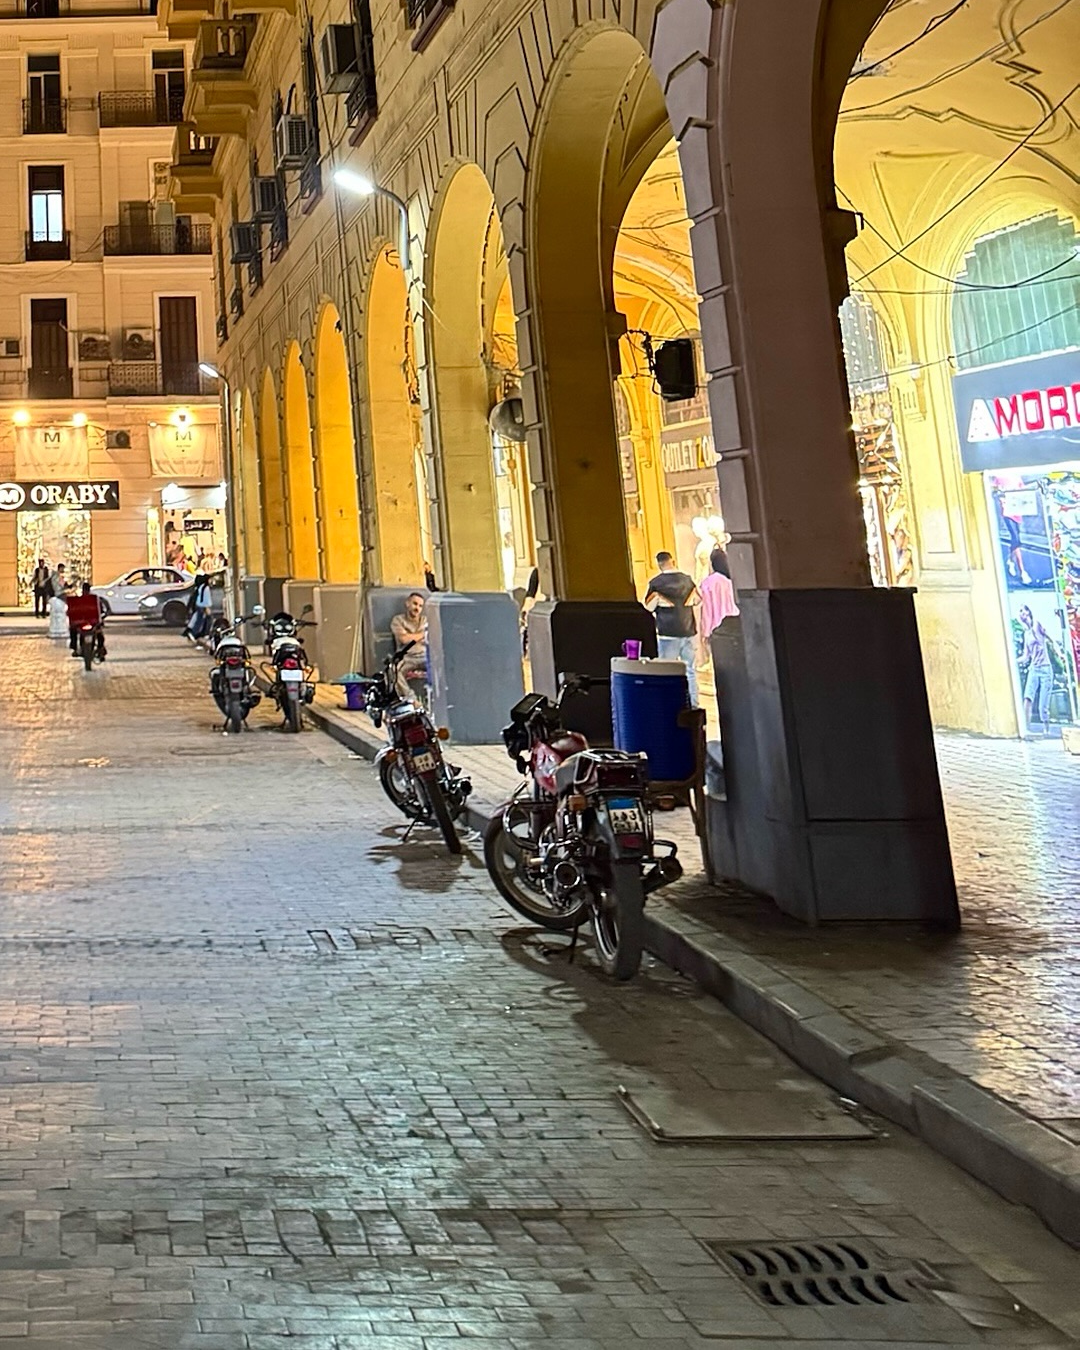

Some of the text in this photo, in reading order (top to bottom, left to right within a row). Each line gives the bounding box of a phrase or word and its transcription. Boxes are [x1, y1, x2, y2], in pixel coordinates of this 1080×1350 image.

[44, 432, 61, 443] M
[661, 439, 695, 473] OUTLET
[30, 484, 110, 505] ORABY
